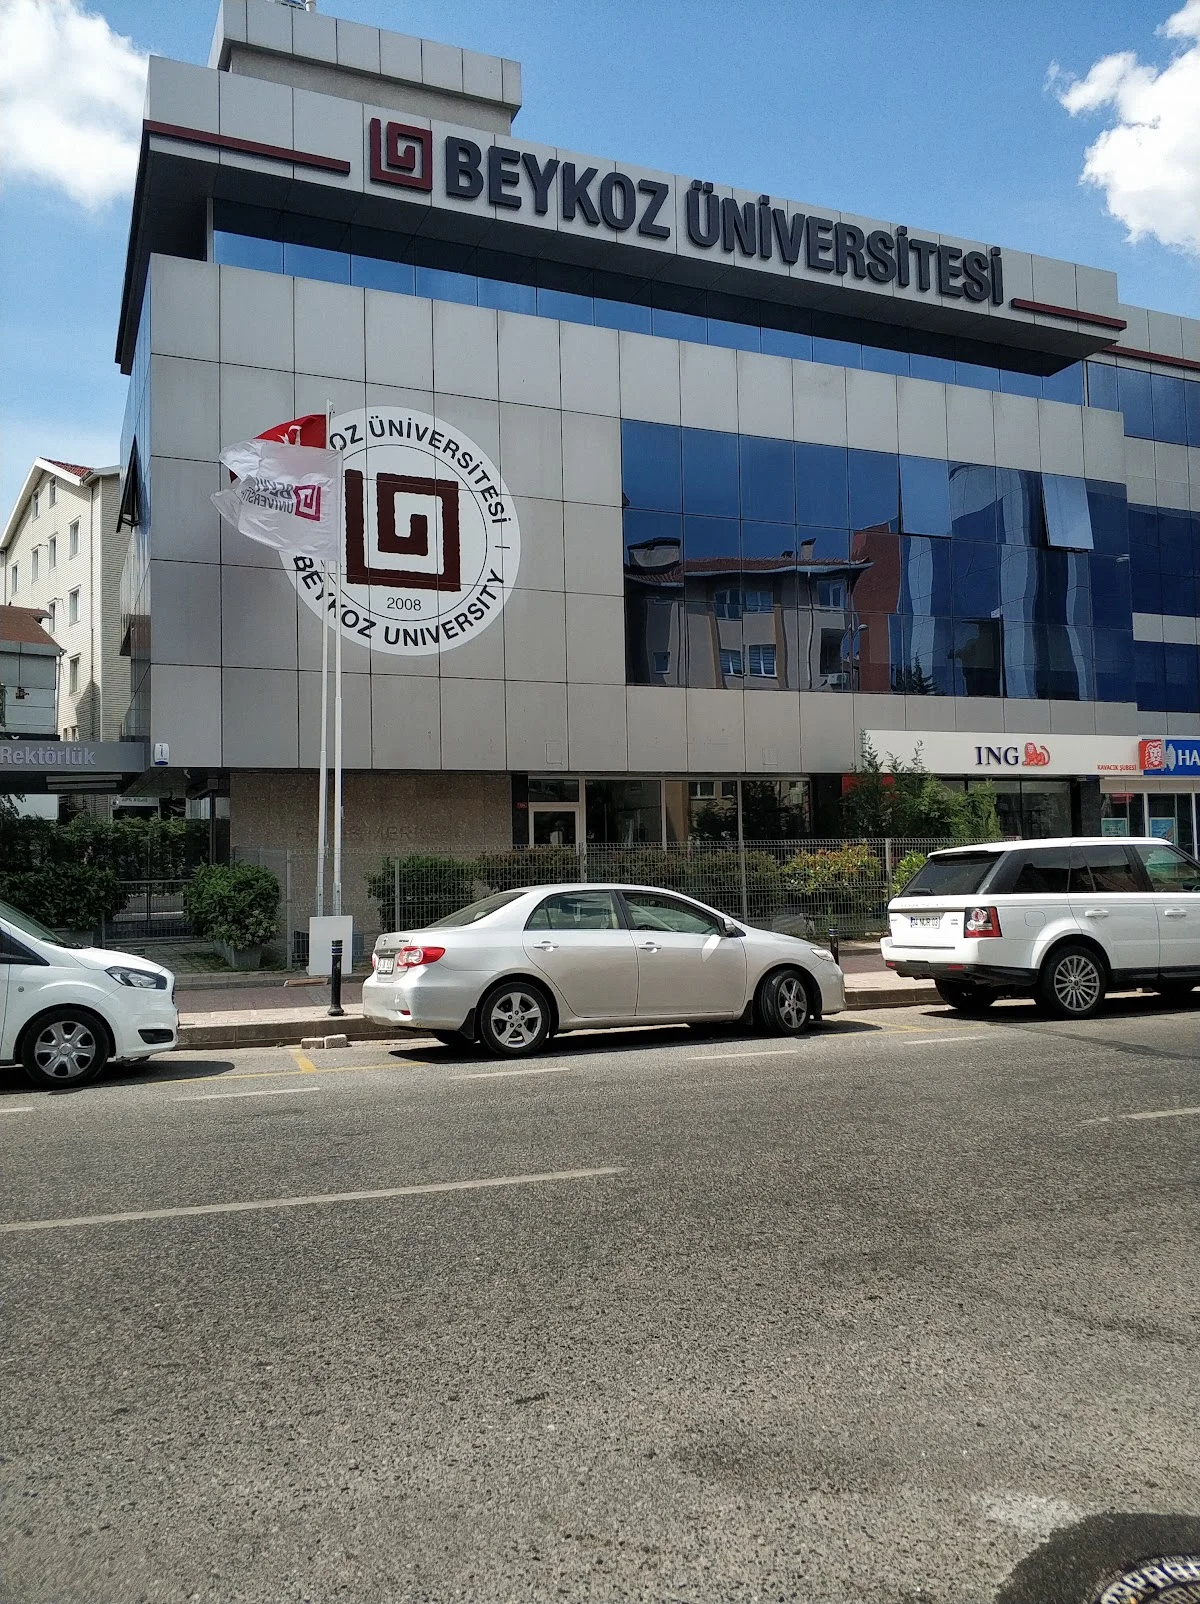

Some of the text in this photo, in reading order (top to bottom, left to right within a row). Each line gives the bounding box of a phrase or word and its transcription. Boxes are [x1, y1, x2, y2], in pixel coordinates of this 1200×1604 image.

[445, 136, 1003, 304] BEYKOZ ÜNİVERSİTESİ
[368, 415, 511, 523] ÜNİVERSİTESİ
[384, 568, 504, 646] UNIVERSITY
[386, 597, 422, 611] 2008
[0, 746, 96, 765] Rektörlük
[974, 746, 1019, 765] ING
